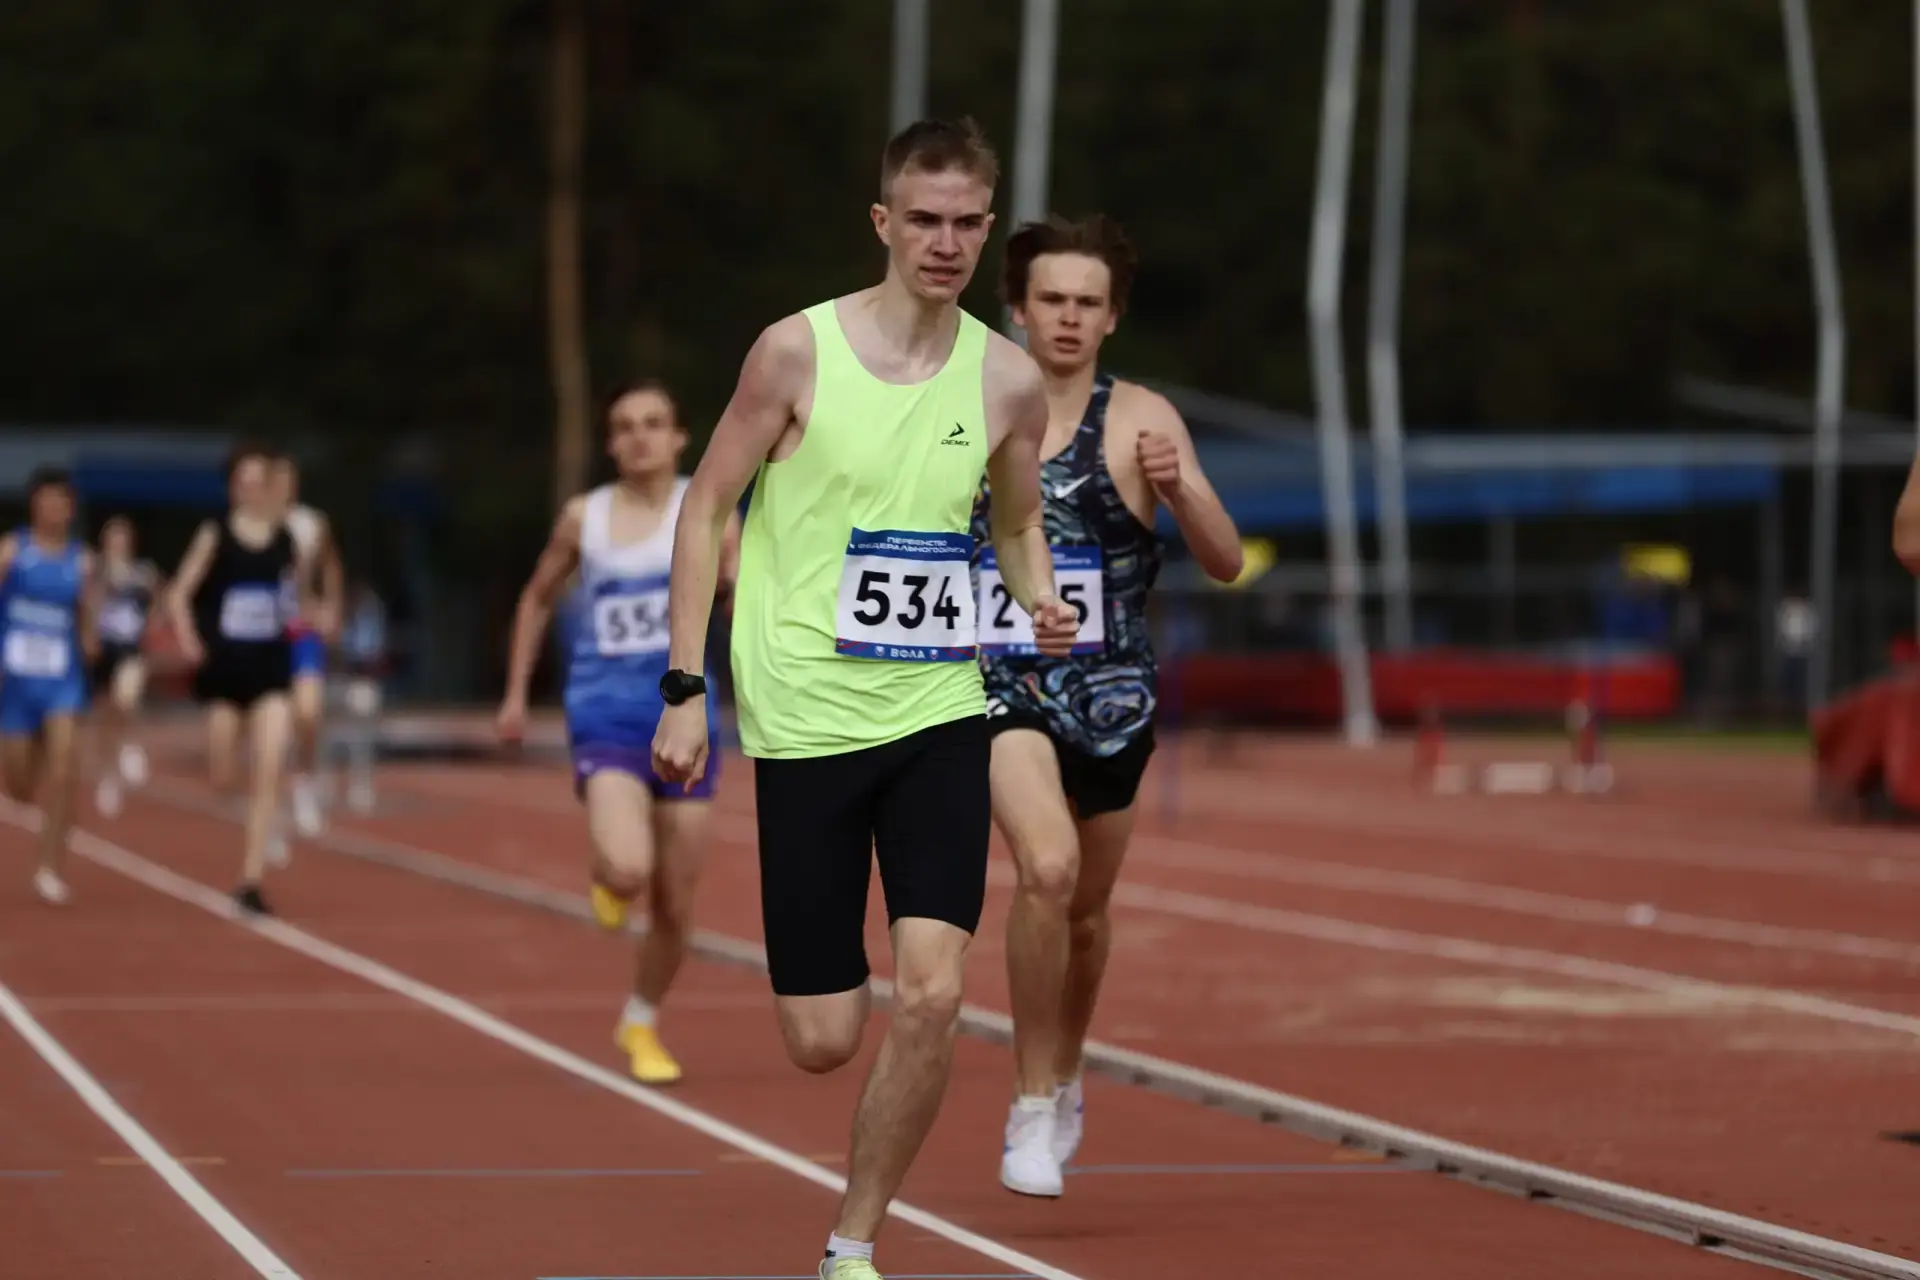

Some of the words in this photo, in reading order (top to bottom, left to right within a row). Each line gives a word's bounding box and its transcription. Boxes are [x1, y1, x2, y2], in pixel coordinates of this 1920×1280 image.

[941, 439, 970, 447] DEMIX
[853, 570, 960, 630] 534
[991, 583, 1089, 628] 25
[608, 603, 670, 642] 55
